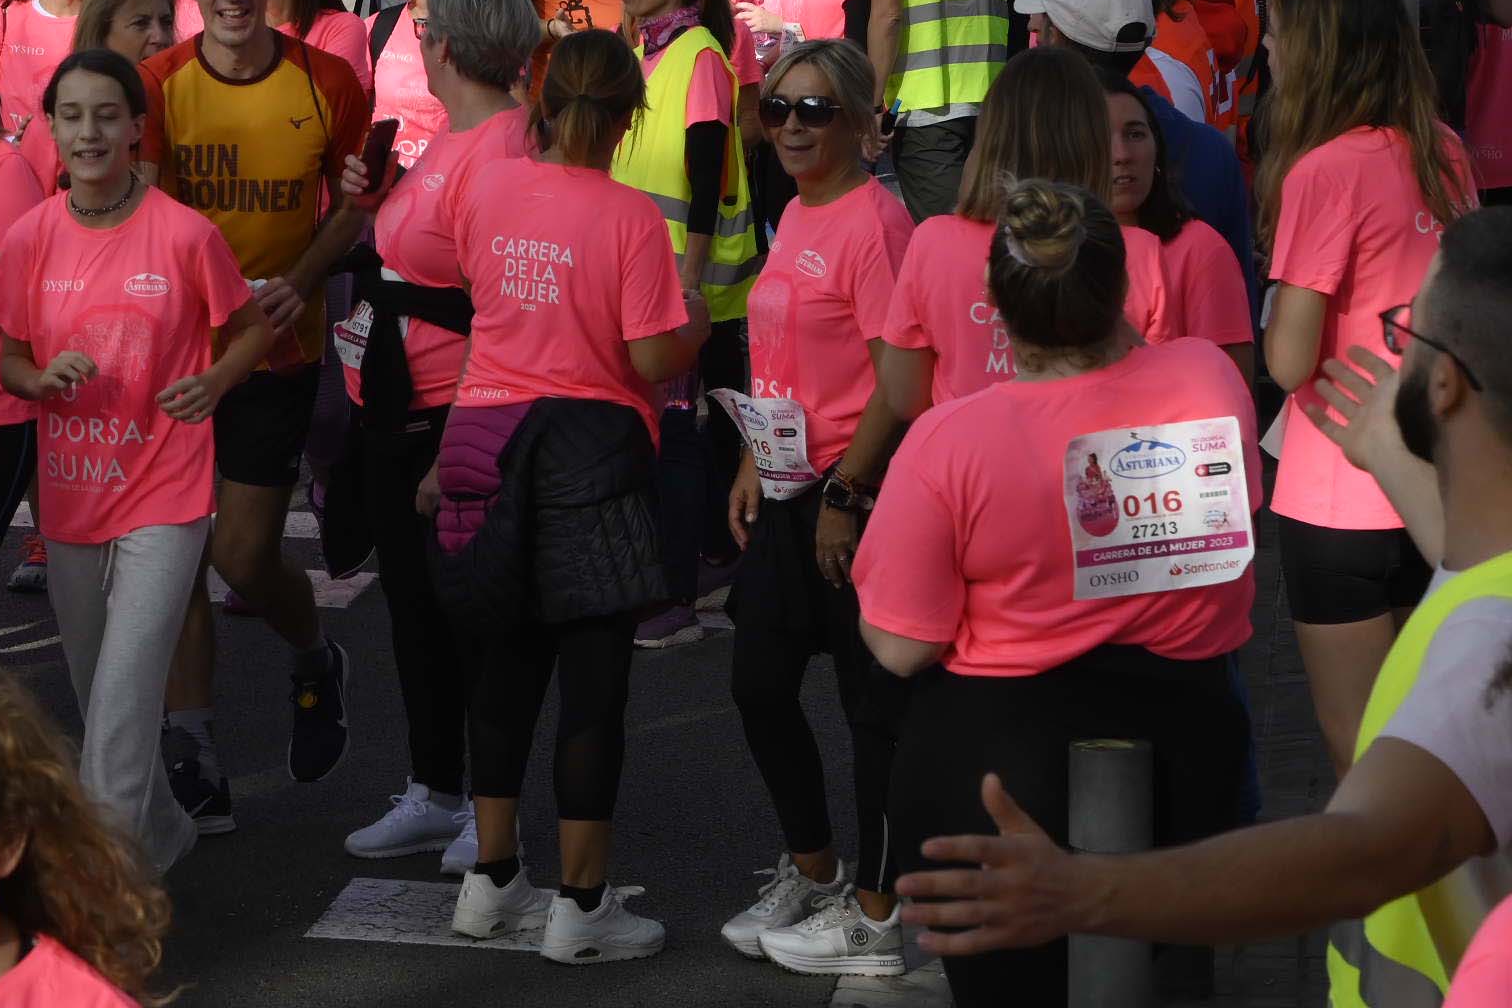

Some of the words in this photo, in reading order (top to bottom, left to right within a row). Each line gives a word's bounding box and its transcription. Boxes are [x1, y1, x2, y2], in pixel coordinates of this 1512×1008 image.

[176, 143, 239, 177] RUN
[491, 236, 574, 268] CARRERA
[504, 258, 527, 279] DE
[532, 263, 557, 284] LA
[42, 279, 85, 292] OYSHO
[127, 280, 168, 292] ASTURIANA
[500, 278, 560, 304] MUJER
[1192, 441, 1228, 453] SUMA
[48, 451, 127, 484] SUMA
[1115, 455, 1181, 473] ASTURIANA
[1123, 490, 1183, 518] 016
[1131, 521, 1178, 539] 27213
[1093, 547, 1136, 563] CARRERA
[1138, 545, 1152, 556] DE
[1154, 544, 1168, 555] LA
[1169, 540, 1206, 553] MUJER
[1209, 536, 1234, 548] 2023
[1183, 559, 1241, 575] Santander
[1089, 570, 1139, 588] OYSHO
